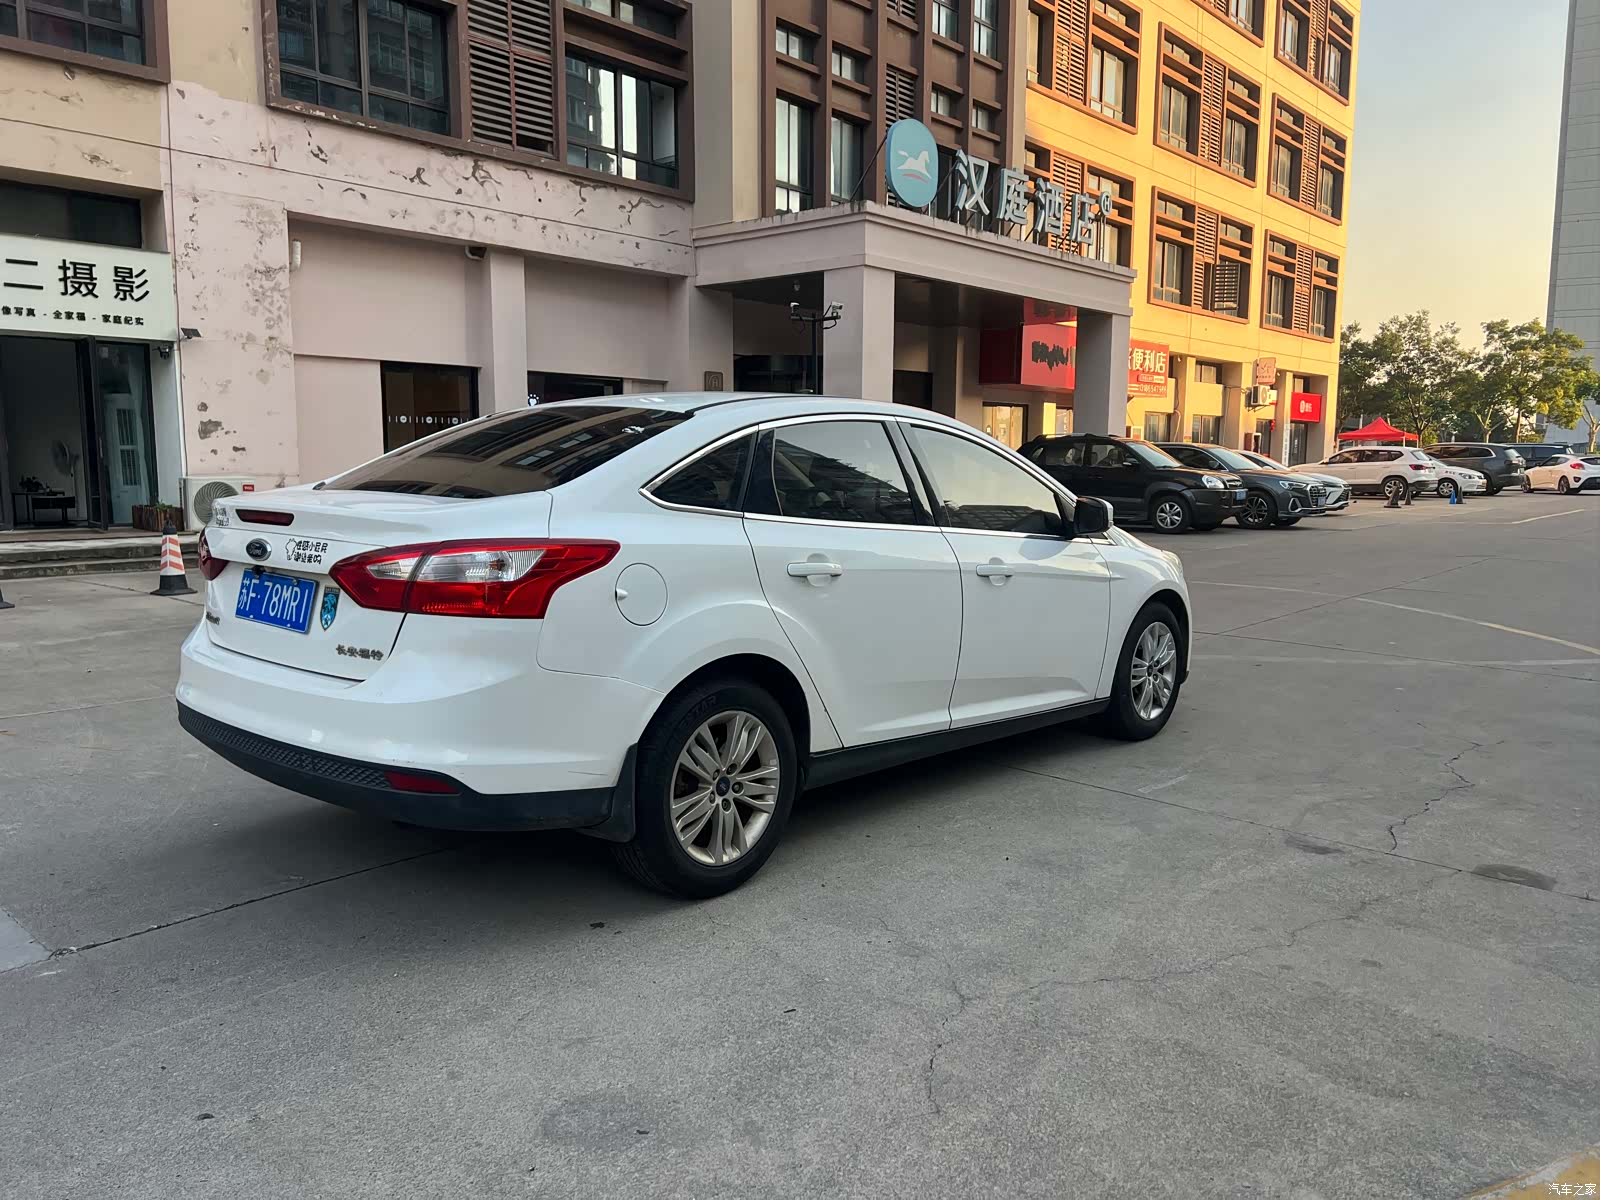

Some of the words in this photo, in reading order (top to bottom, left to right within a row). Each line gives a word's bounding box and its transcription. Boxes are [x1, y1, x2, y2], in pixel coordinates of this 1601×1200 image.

[954, 149, 1096, 246] 汉庭酒店
[4, 258, 150, 302] 二摄影
[2, 305, 36, 318] 像写真
[52, 310, 87, 322] 全家福
[101, 314, 144, 326] 家庭纪实
